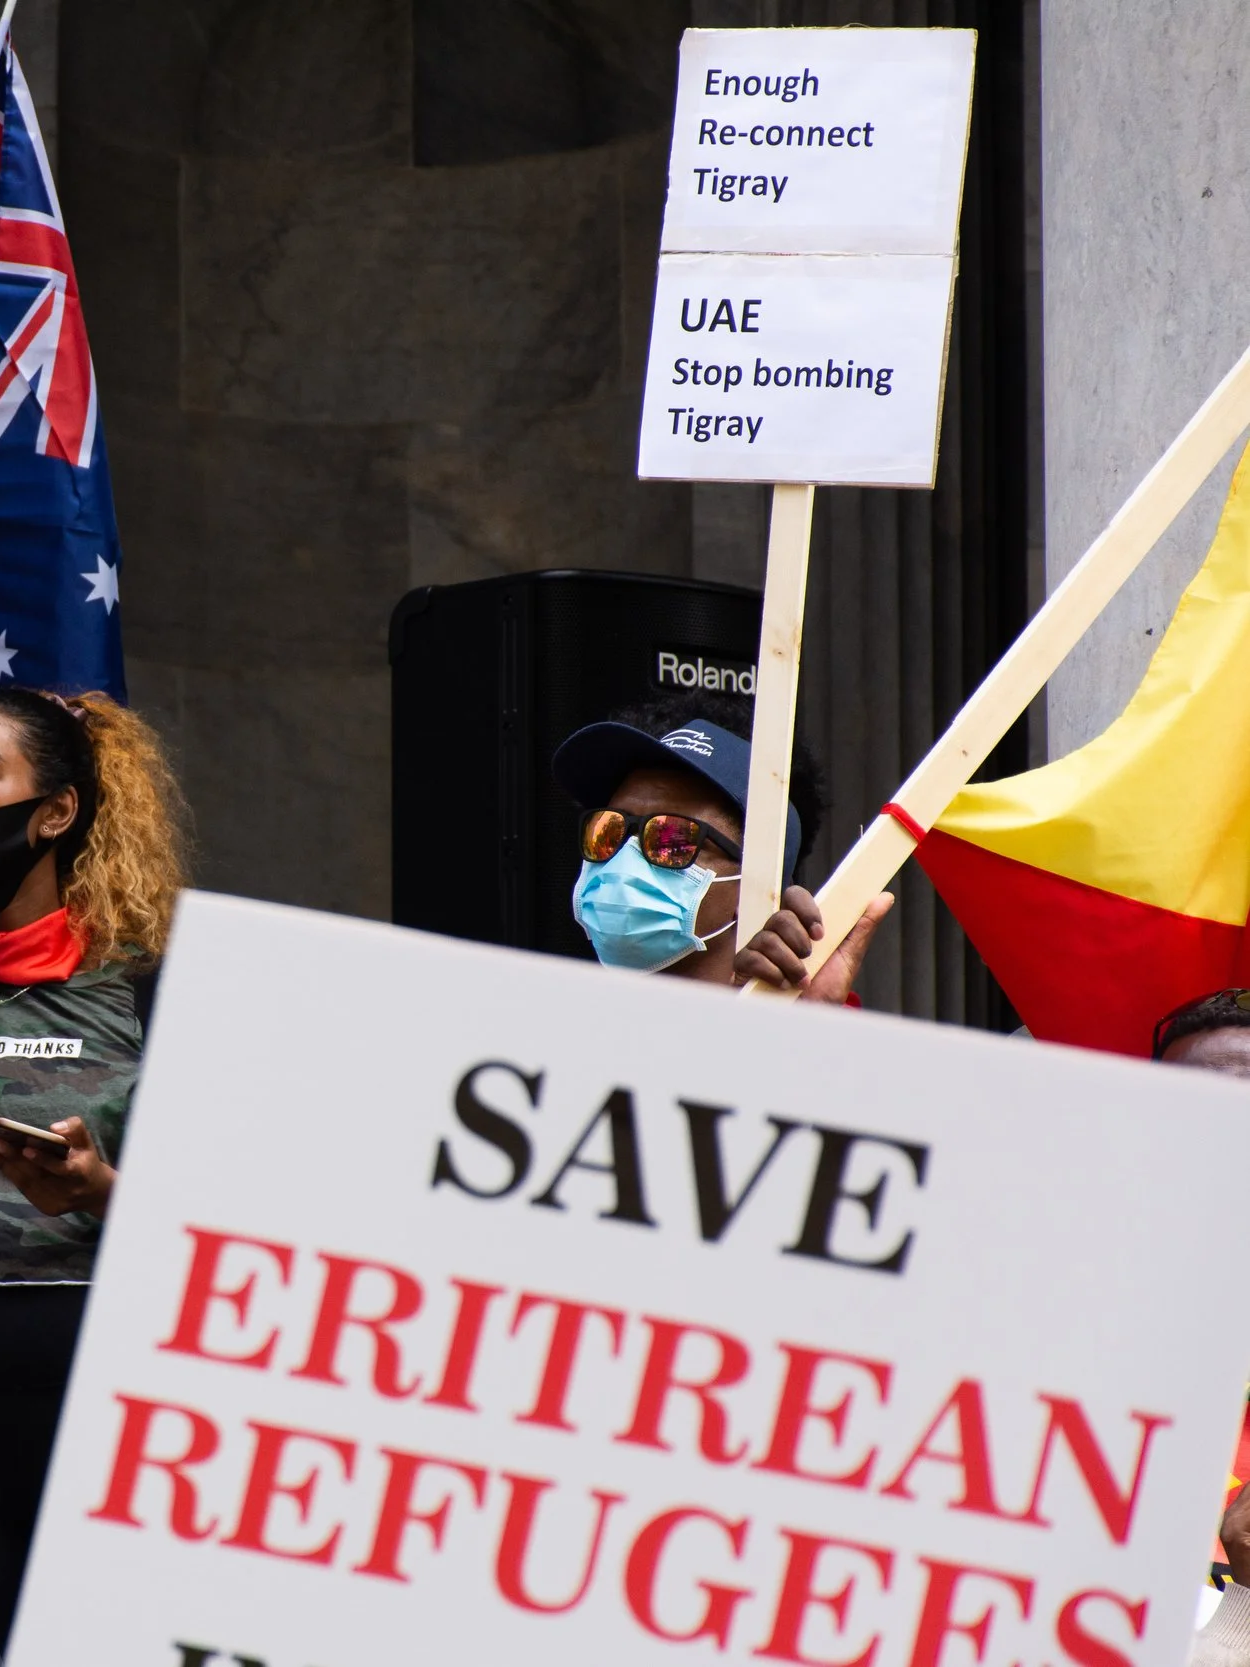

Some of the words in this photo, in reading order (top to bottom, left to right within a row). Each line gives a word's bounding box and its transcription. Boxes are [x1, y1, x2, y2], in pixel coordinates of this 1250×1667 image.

[704, 67, 819, 103] Enough
[698, 118, 875, 148] Re-connect
[693, 167, 789, 204] Tigray
[680, 298, 762, 333] UAE
[672, 357, 743, 393] Stop
[753, 357, 894, 396] bombing
[667, 407, 764, 444] Tigray
[658, 652, 757, 696] Roland
[14, 1042, 75, 1054] THANKS
[431, 1058, 930, 1275] SAVE
[156, 1224, 1172, 1548] ERITREAN
[87, 1393, 1150, 1667] REFUGEES
